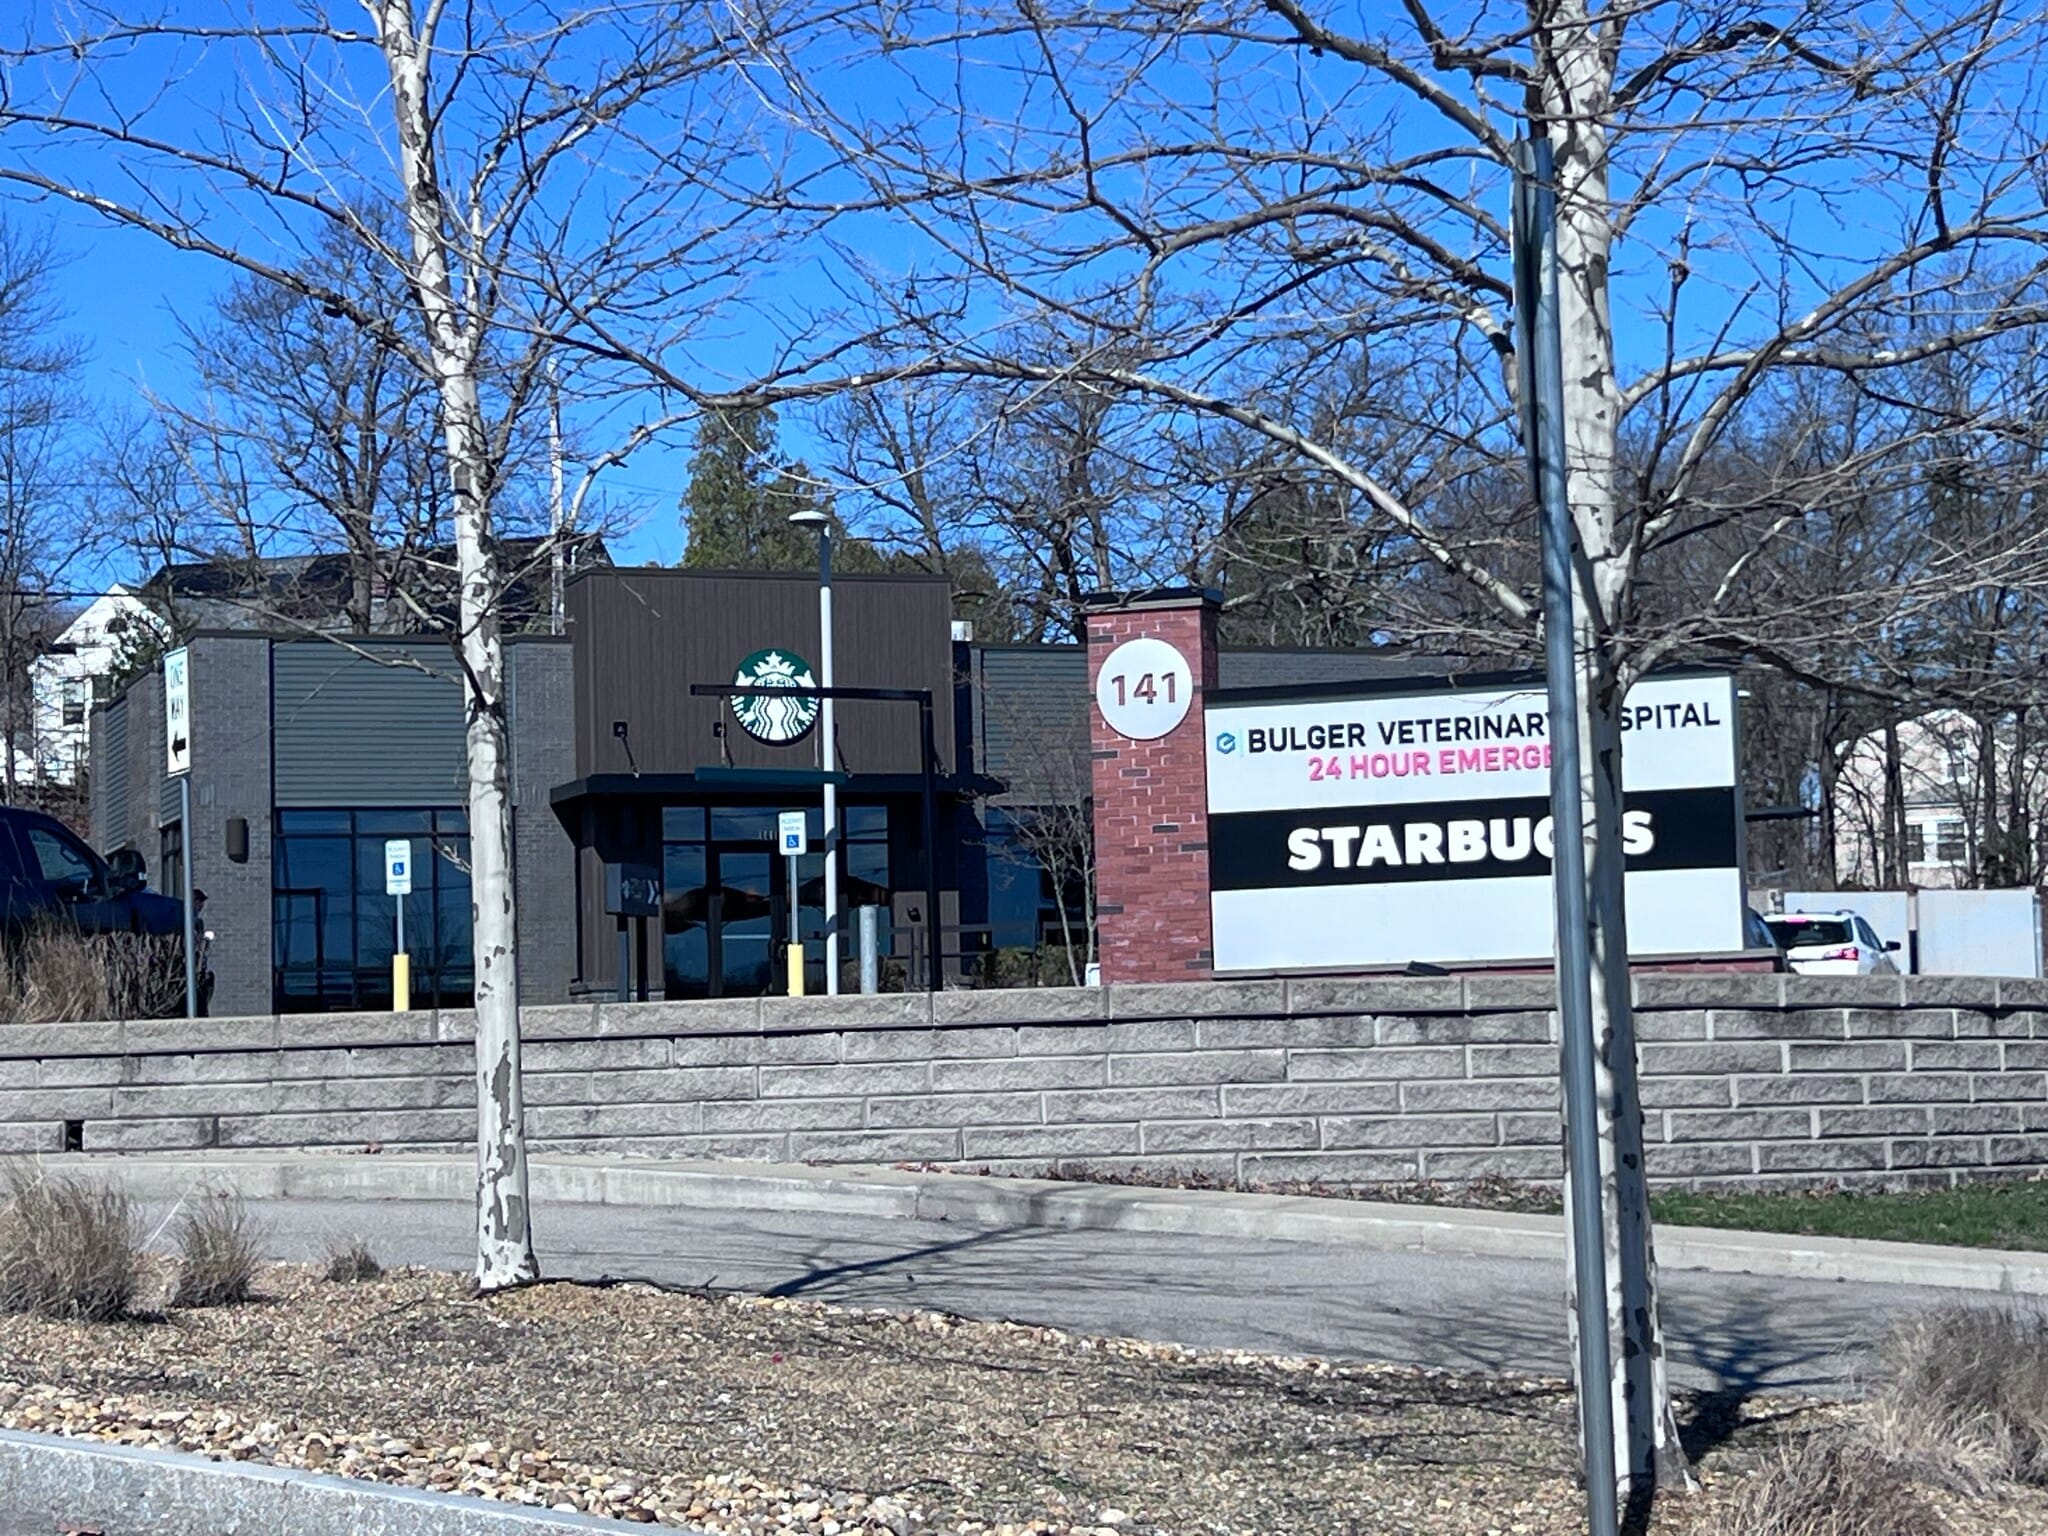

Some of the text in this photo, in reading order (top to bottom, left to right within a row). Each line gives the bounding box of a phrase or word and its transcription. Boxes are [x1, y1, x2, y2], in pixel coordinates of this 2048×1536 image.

[1111, 672, 1175, 706] 141
[1248, 702, 1721, 754] BULGER VETERINAR SPITAL
[1308, 744, 1552, 782] 24 HOUR EMERGE
[1286, 811, 1656, 872] STARBUCS
